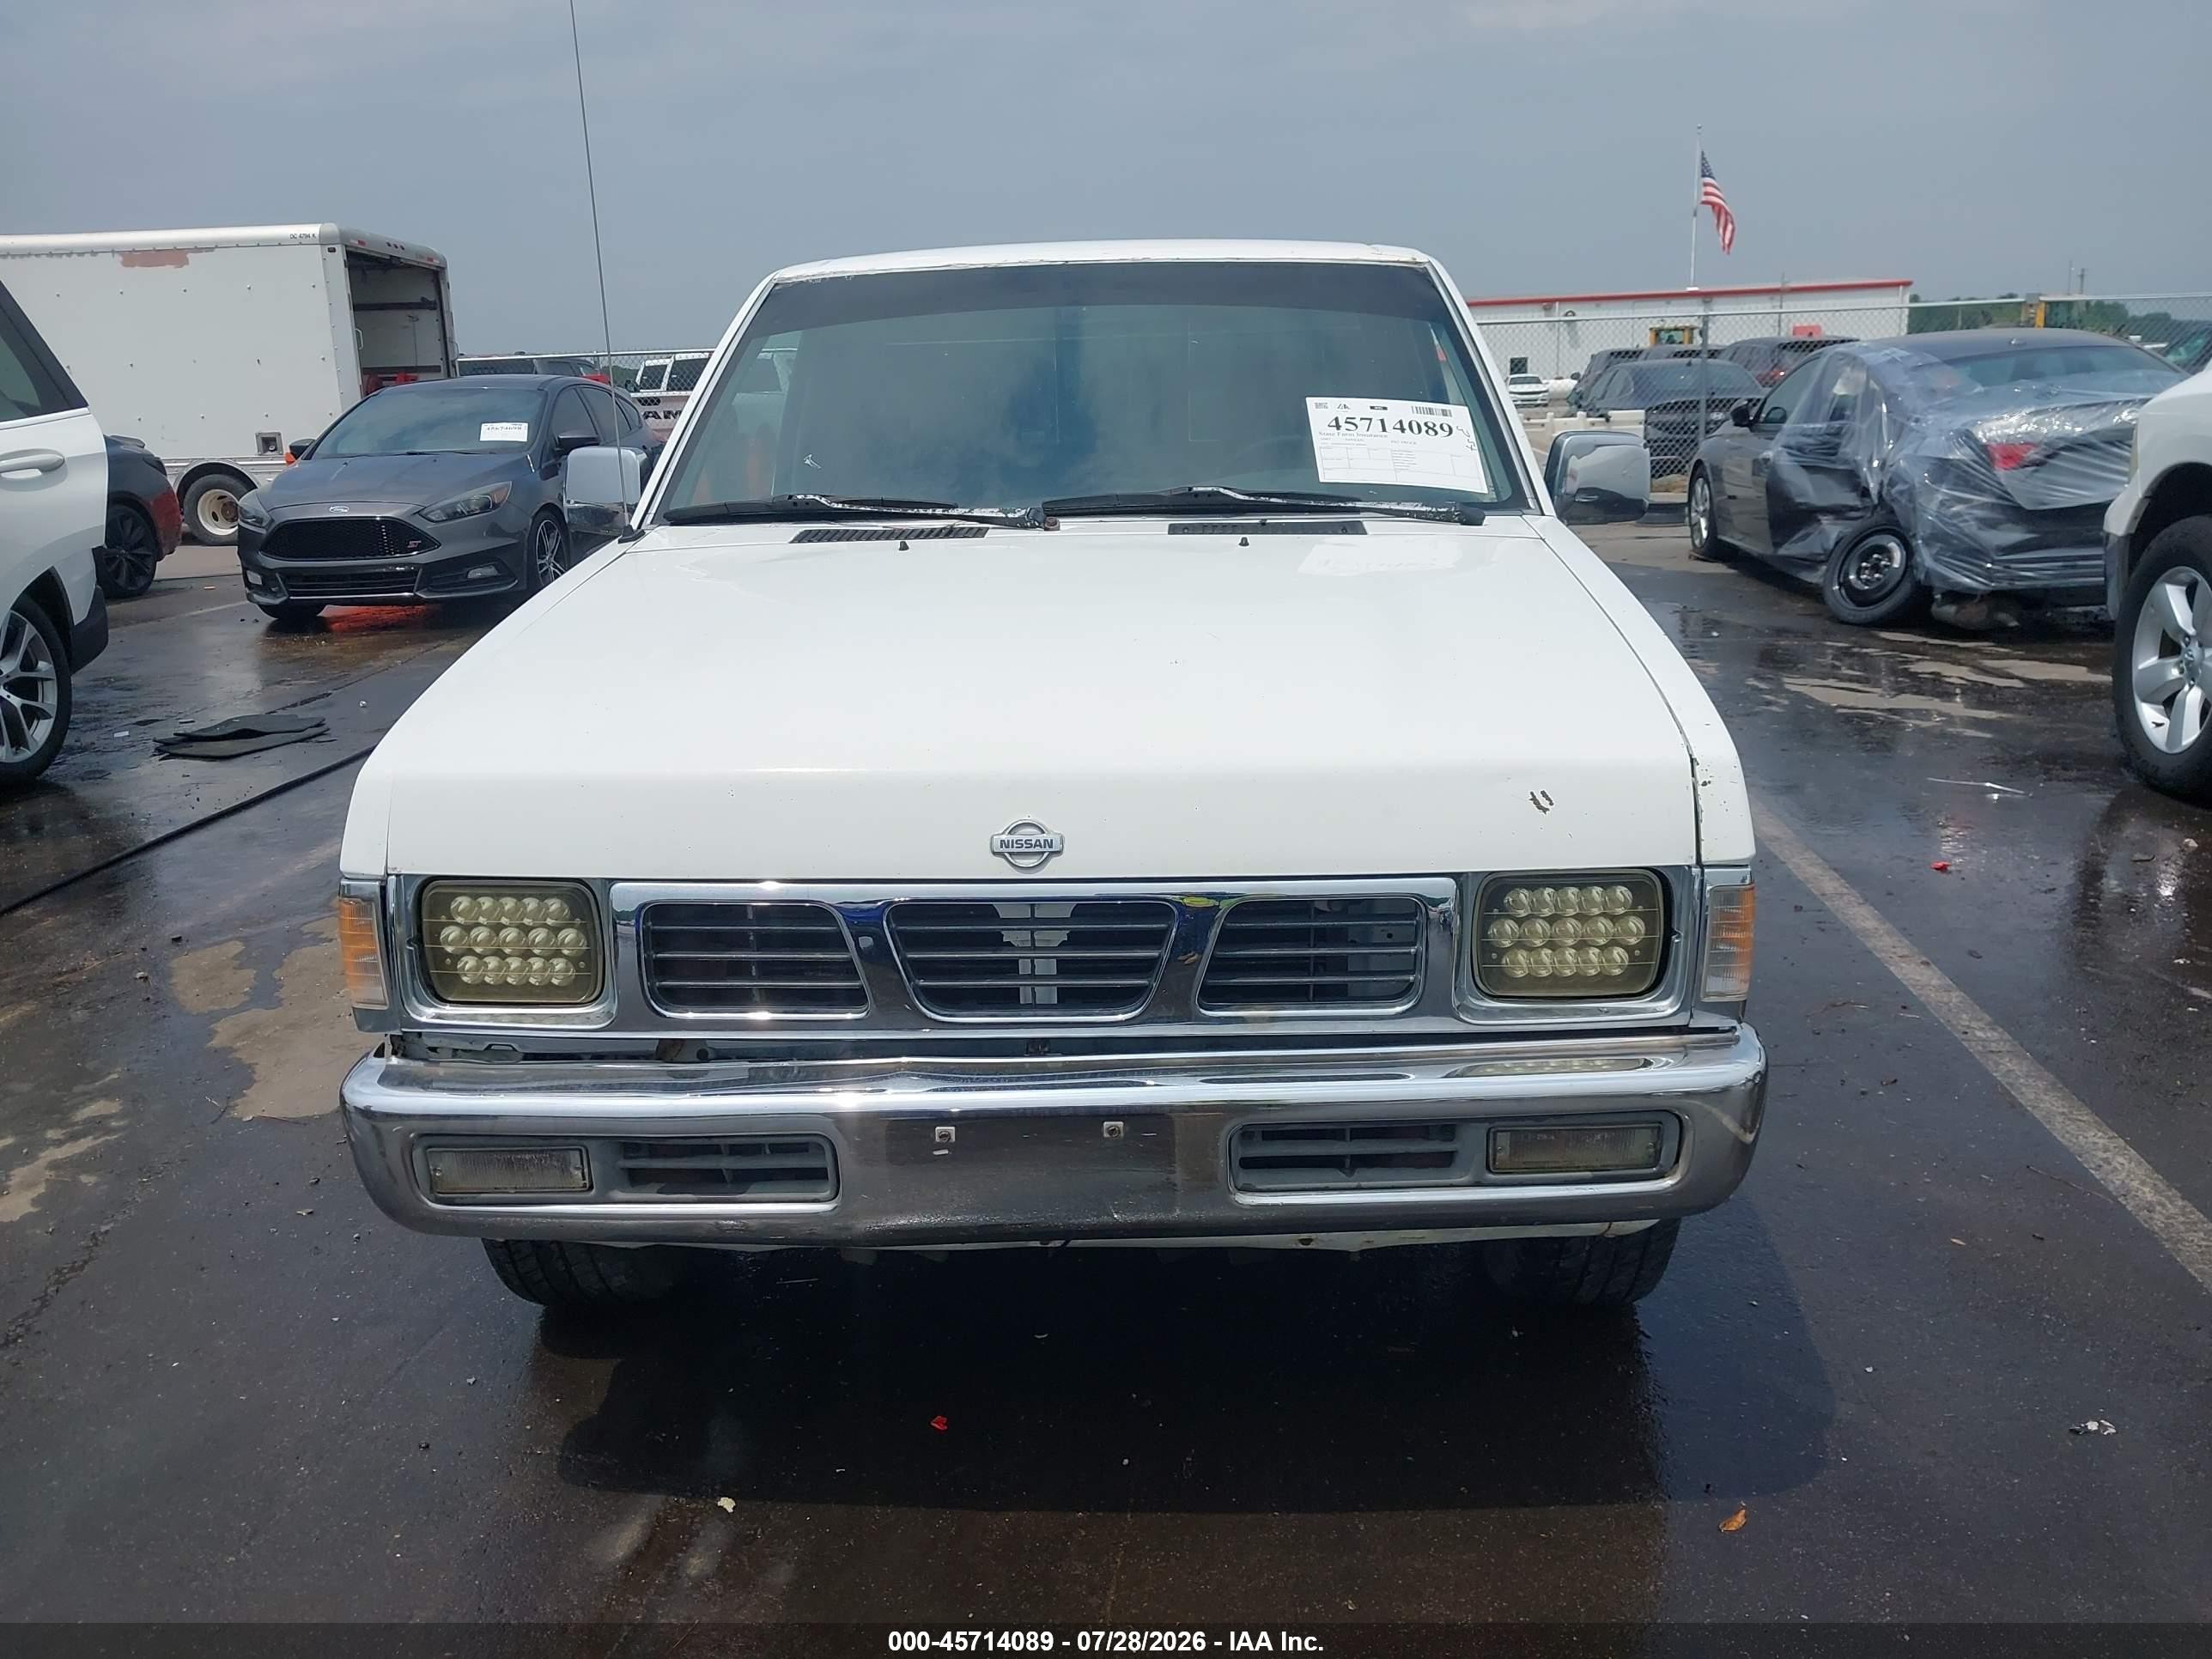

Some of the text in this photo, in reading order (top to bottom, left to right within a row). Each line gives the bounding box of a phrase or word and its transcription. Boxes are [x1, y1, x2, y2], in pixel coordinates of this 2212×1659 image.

[642, 410, 684, 420] AM
[1327, 415, 1455, 438] 45714089
[1000, 838, 1054, 849] NISSAN
